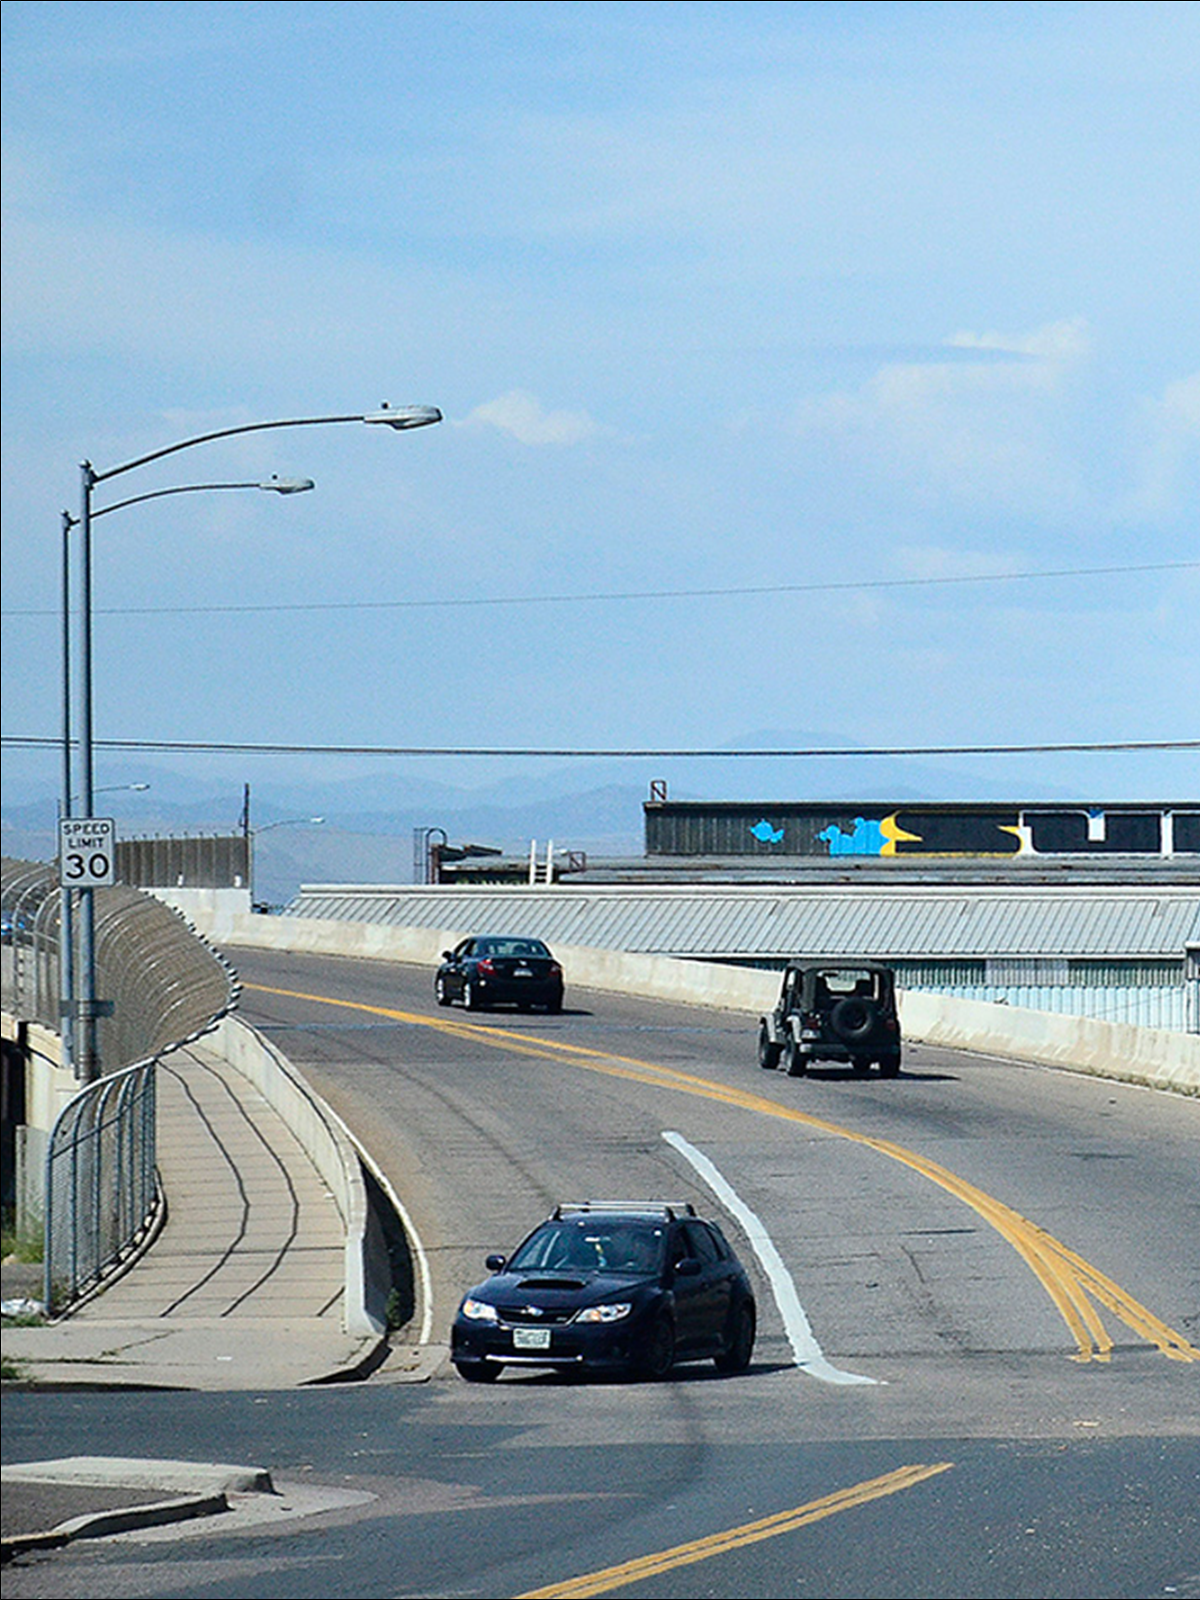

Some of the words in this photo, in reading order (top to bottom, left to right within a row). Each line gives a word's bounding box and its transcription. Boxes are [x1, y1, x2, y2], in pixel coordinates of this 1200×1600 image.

[63, 823, 110, 835] SPEED
[68, 838, 104, 848] LIMIT
[66, 853, 110, 879] 30
